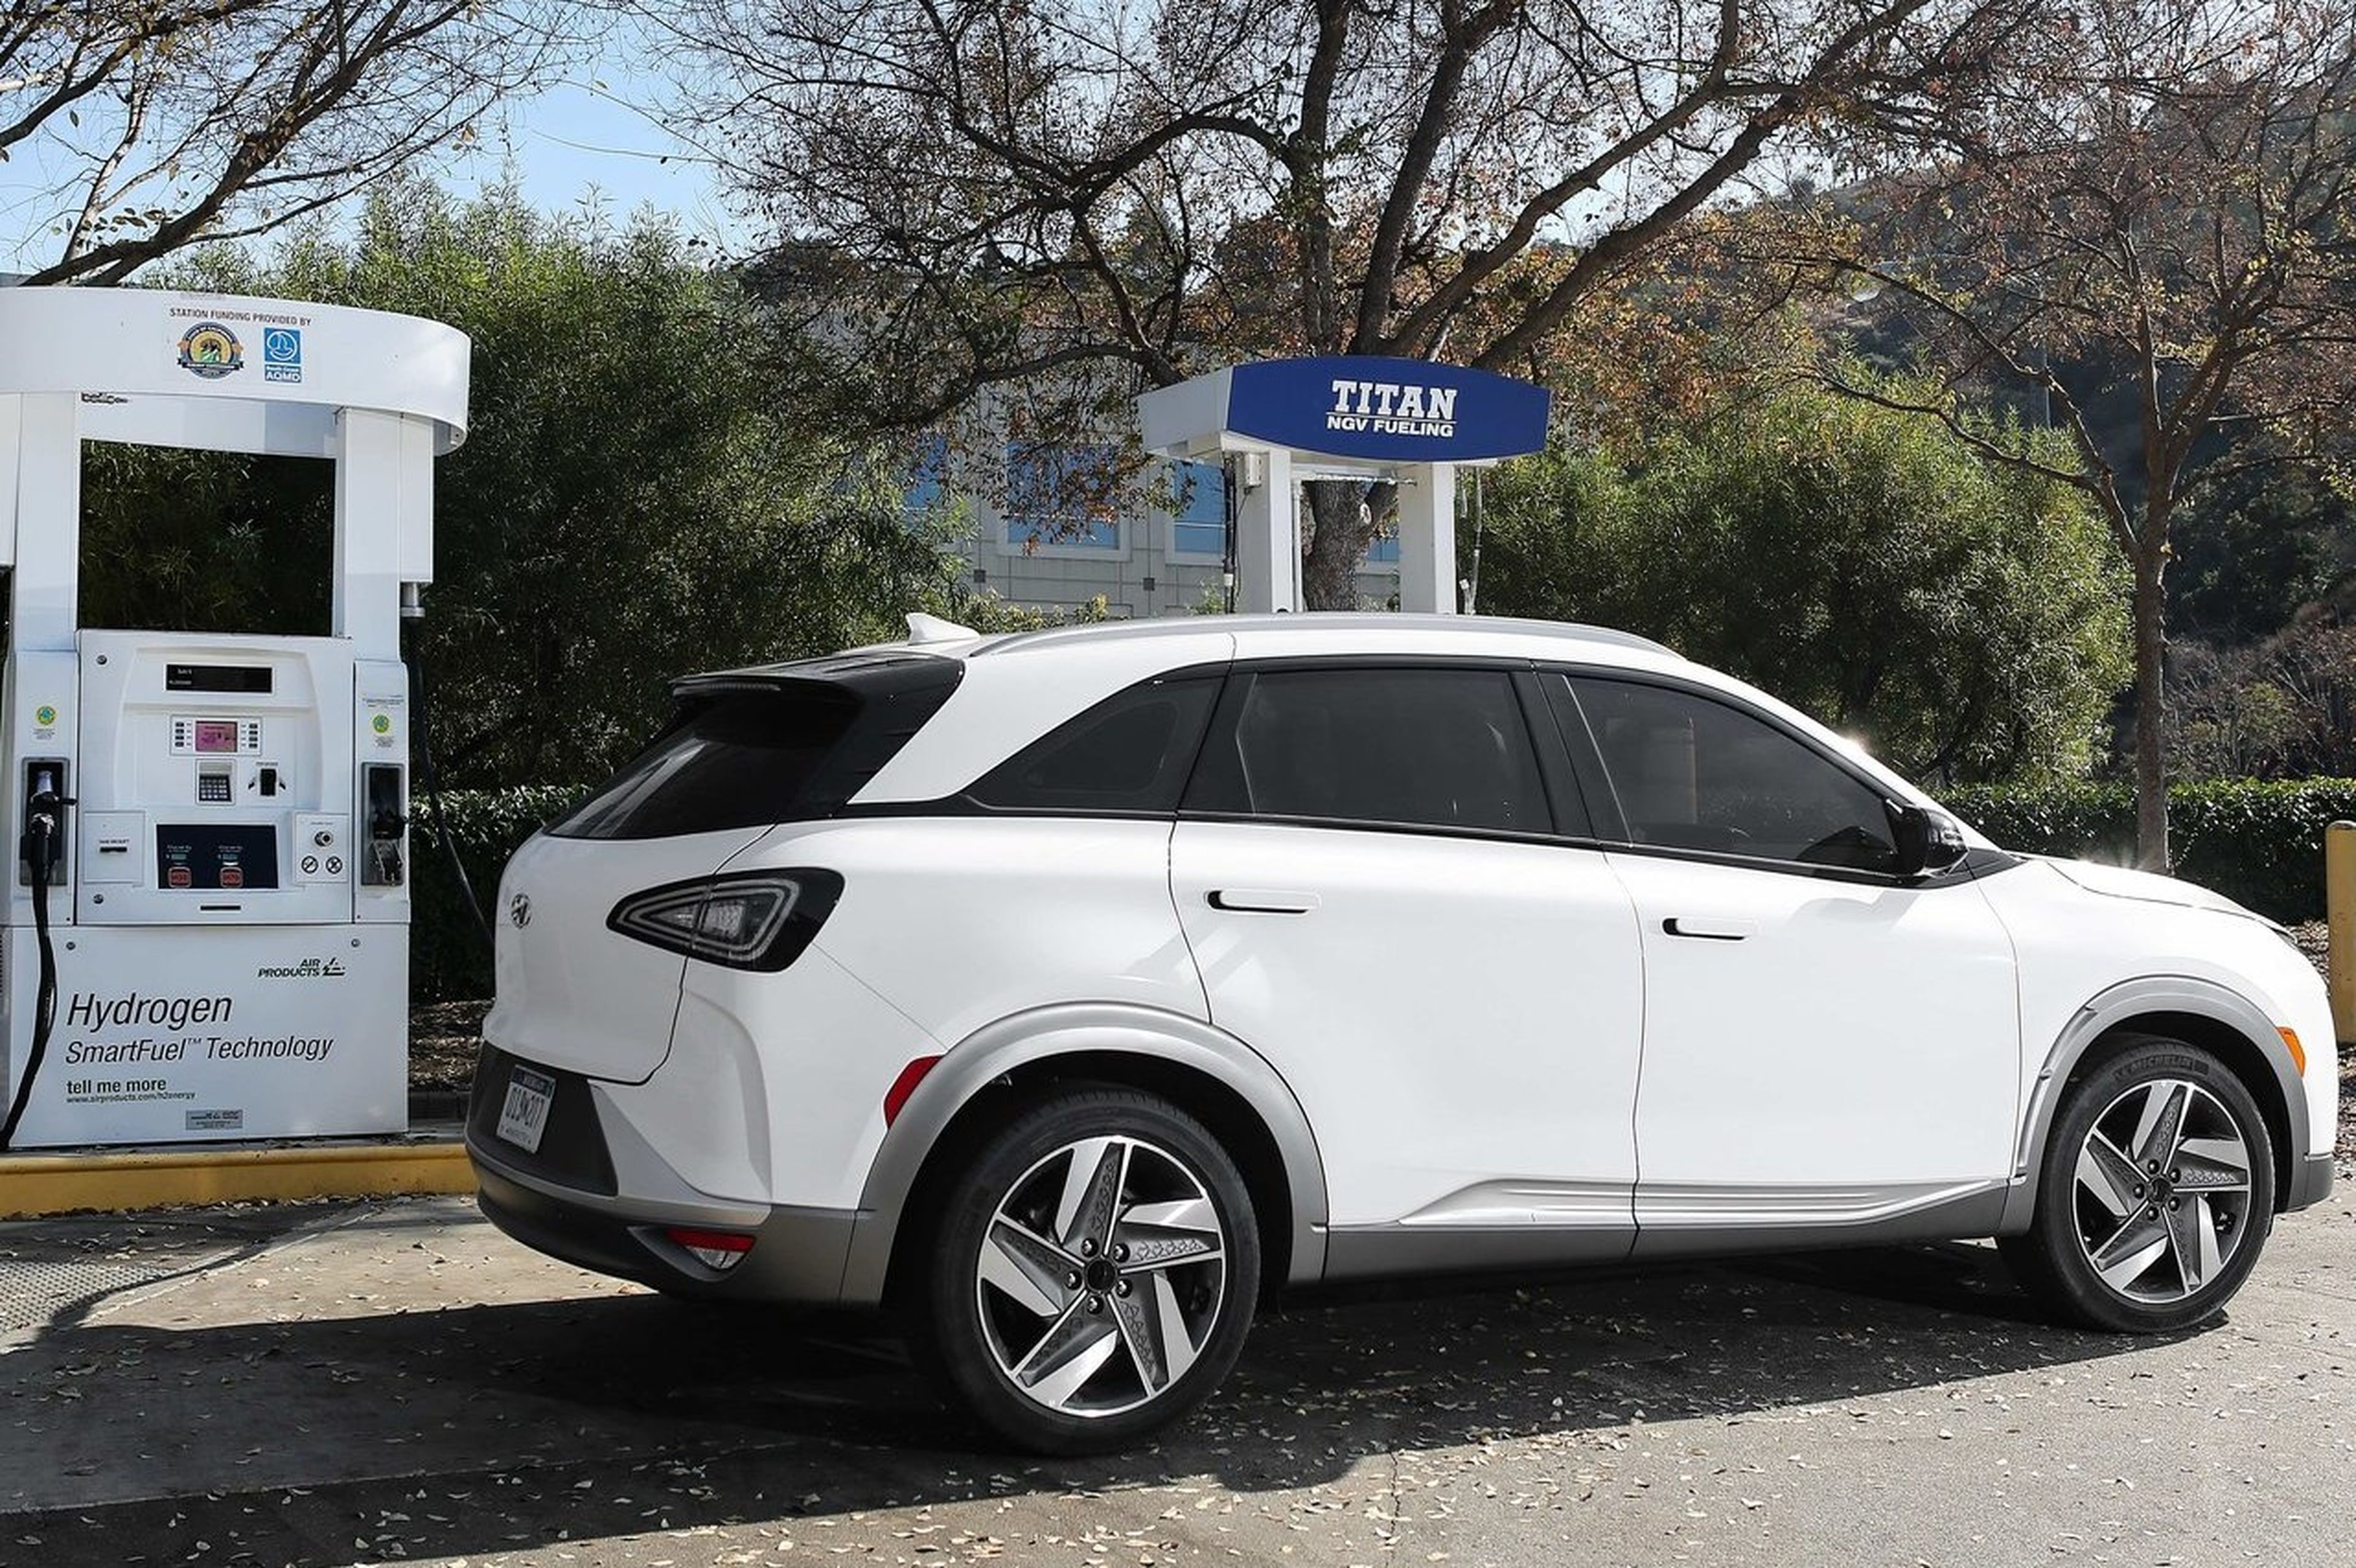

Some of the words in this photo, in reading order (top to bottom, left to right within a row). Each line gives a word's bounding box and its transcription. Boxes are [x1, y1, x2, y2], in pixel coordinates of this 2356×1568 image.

[170, 307, 207, 318] STATION
[210, 310, 251, 321] FUNDING
[252, 313, 298, 326] PROVIDED
[299, 317, 312, 326] BY
[1332, 380, 1458, 420] TITAN
[1327, 416, 1368, 431] NGV
[1373, 420, 1453, 437] FUELING
[258, 967, 320, 977] PRODUCTS
[299, 958, 321, 967] AIR
[66, 992, 233, 1033] Hydrogen
[207, 1035, 334, 1061] Technology
[66, 1080, 91, 1094] tell
[97, 1080, 121, 1093] me
[126, 1079, 167, 1092] more
